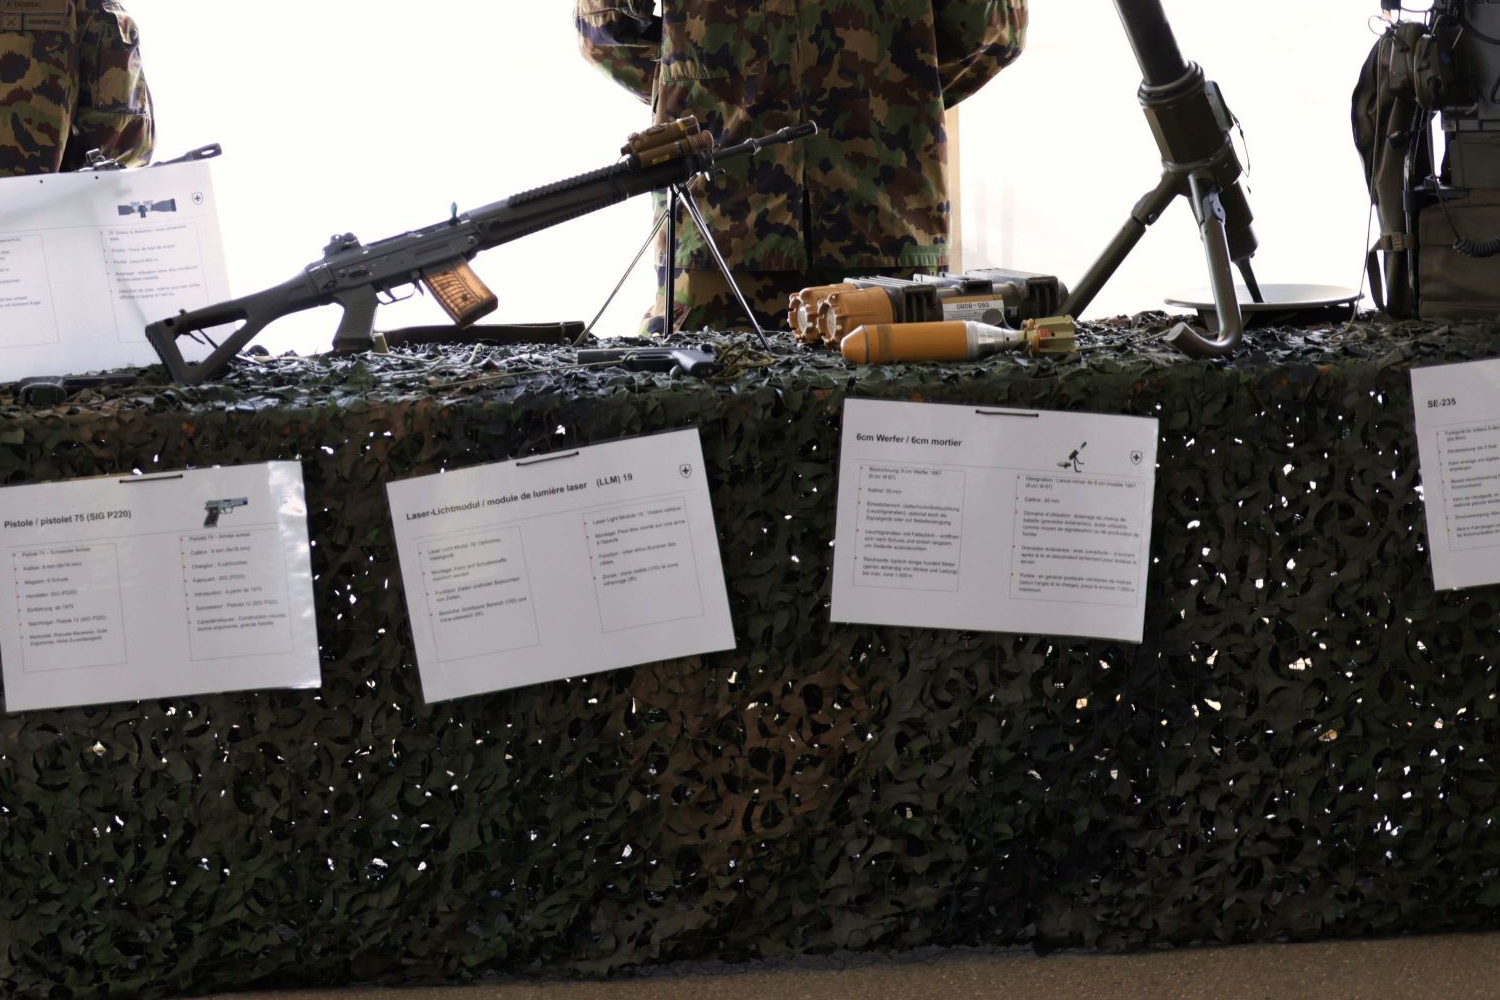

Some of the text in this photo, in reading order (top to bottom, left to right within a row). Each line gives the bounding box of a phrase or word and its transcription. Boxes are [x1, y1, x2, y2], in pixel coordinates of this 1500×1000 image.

[1427, 397, 1456, 407] SE-235
[876, 434, 903, 442] Werfer
[911, 436, 928, 444] 6cm
[931, 438, 961, 446] mortier
[406, 501, 479, 520] Laser-Lichtmodul
[487, 494, 518, 505] module
[533, 486, 564, 497] lumière
[566, 481, 586, 491] laser
[596, 475, 620, 487] (LLM)
[4, 519, 33, 528] Pistole
[40, 515, 71, 525] pistolet
[86, 512, 104, 521] (SIG
[107, 510, 131, 520] P220)
